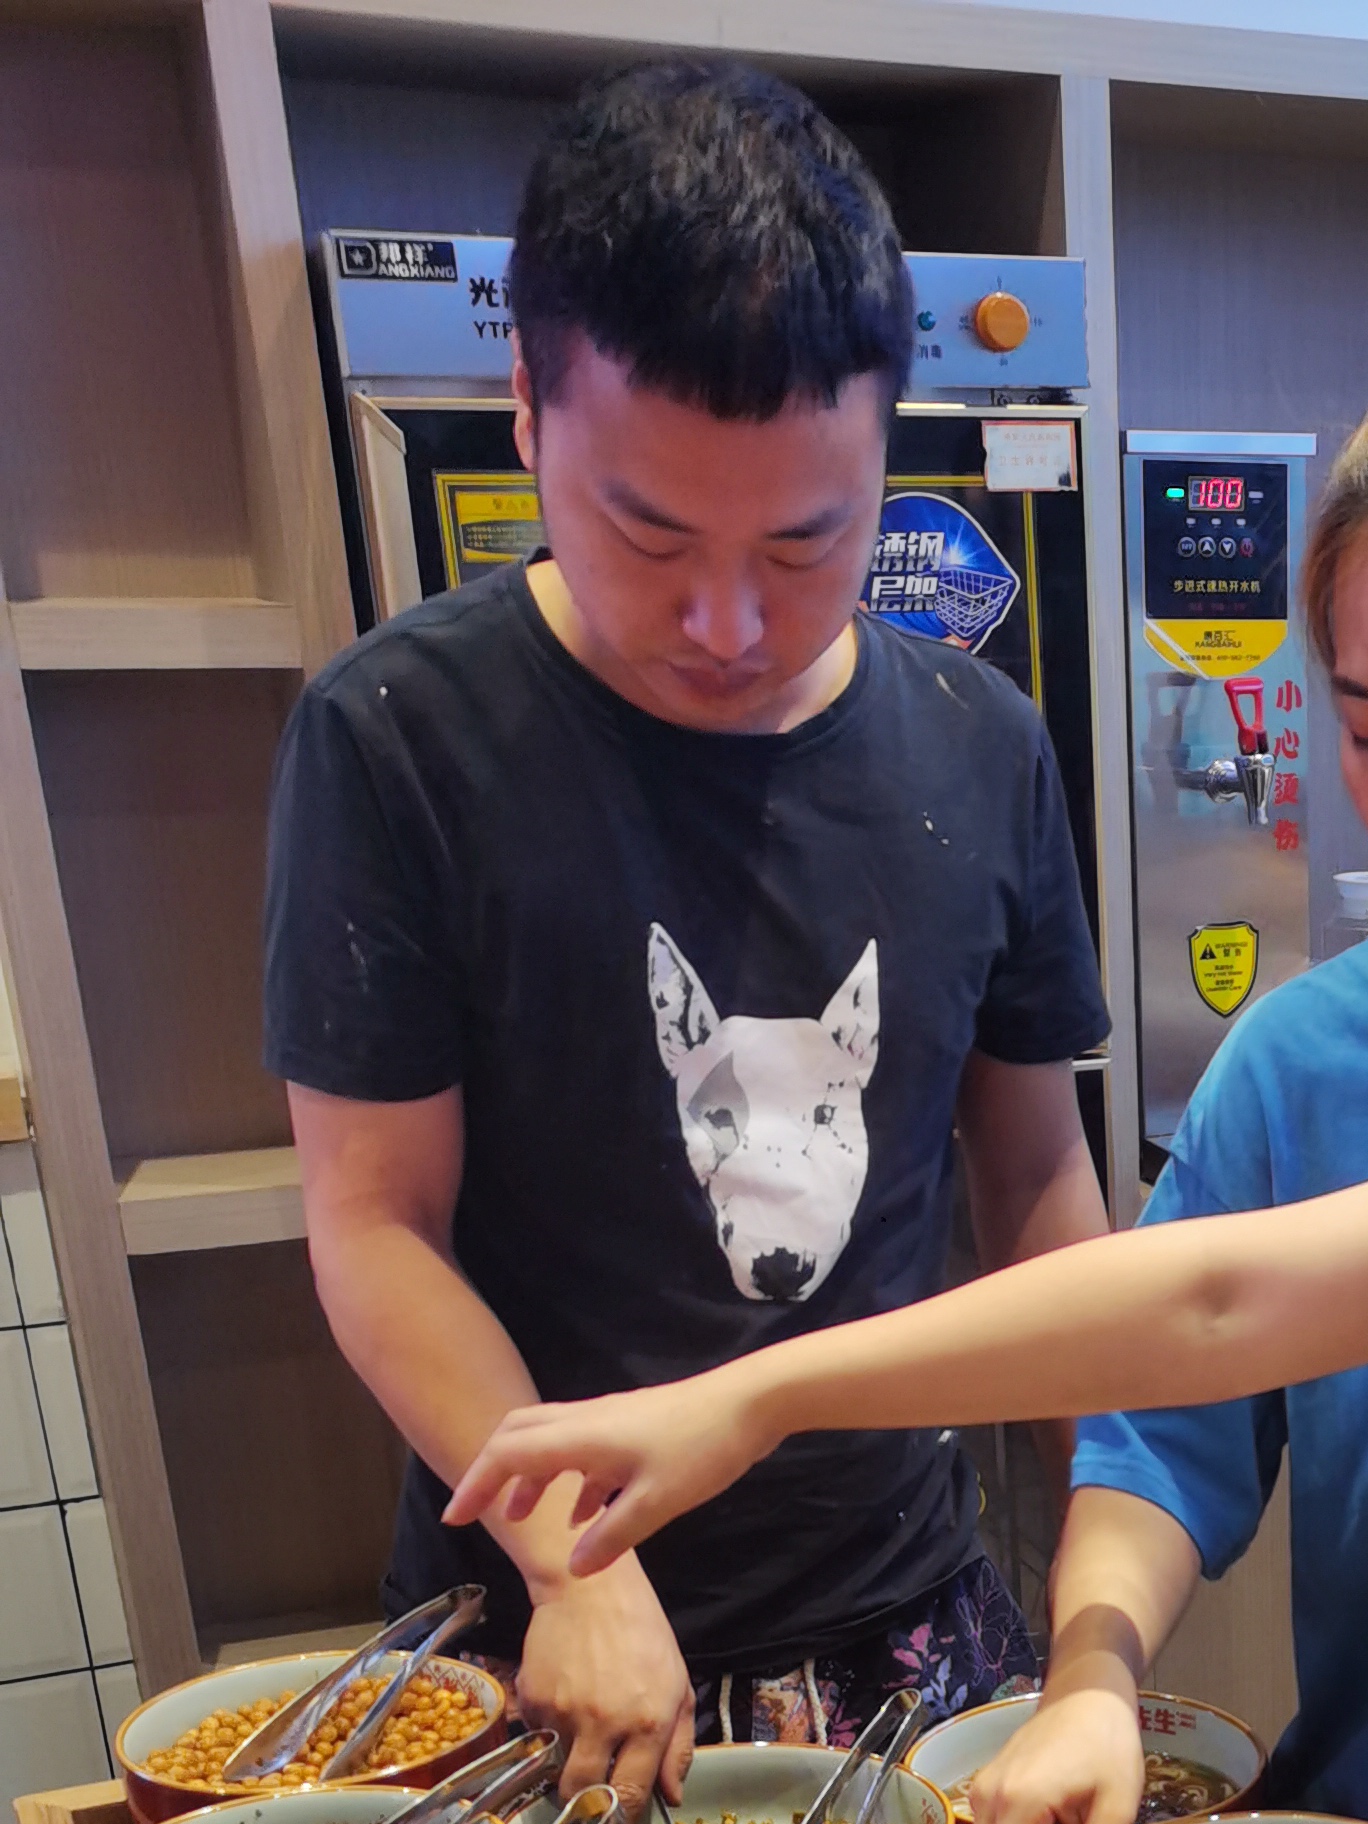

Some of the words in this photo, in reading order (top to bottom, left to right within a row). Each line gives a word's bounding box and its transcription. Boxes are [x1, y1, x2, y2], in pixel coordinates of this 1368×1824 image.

[469, 276, 512, 308] 光
[1198, 477, 1244, 510] 100
[1274, 679, 1302, 851] 小心烫伤
